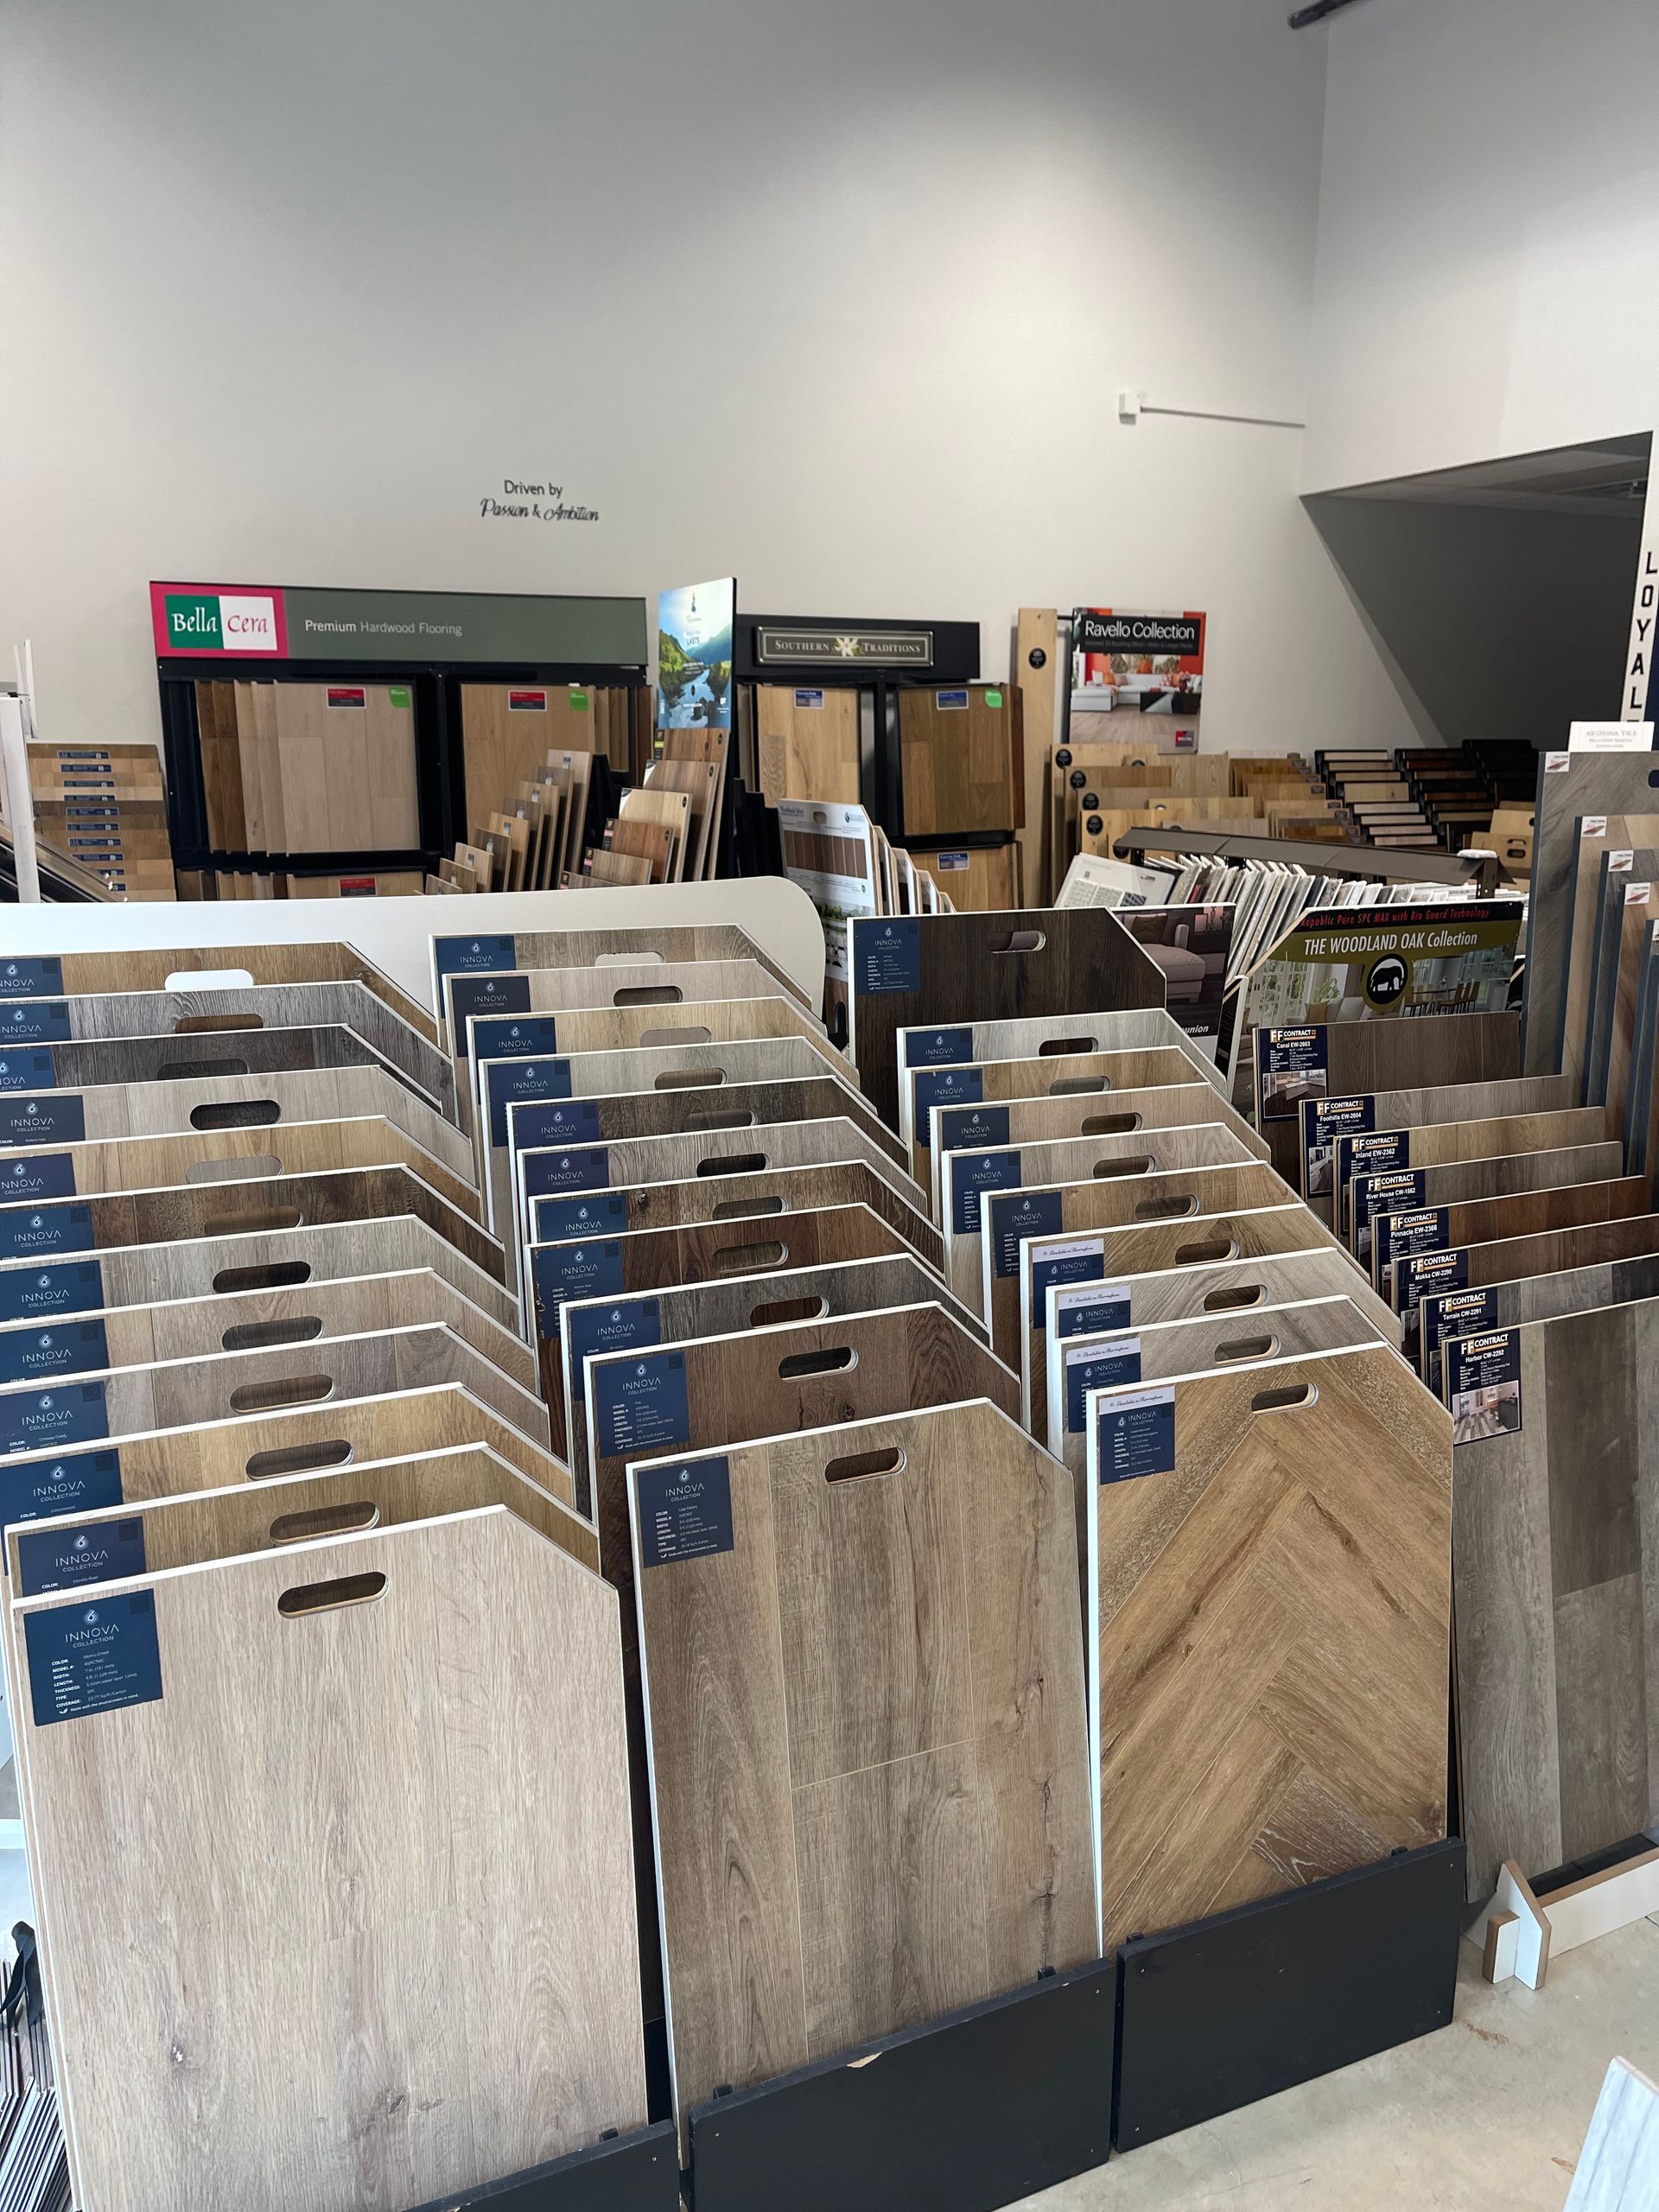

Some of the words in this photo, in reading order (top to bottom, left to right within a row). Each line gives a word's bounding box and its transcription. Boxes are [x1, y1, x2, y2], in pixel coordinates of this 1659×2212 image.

[504, 479, 544, 495] Driven
[549, 482, 563, 499] by
[480, 498, 529, 518] Passion
[532, 503, 542, 518] &
[543, 503, 601, 521] Ambition
[172, 607, 218, 632] Bella
[227, 614, 268, 633] Cera
[305, 620, 357, 633] Premium
[359, 620, 416, 634] Hardwood
[418, 622, 463, 637] Flooring
[1084, 620, 1131, 638] Ravello
[1133, 621, 1195, 640] Collection
[1628, 551, 1658, 722] LOYAL
[774, 639, 830, 651] SOUTHERN
[862, 641, 921, 652] TRADITIONS
[1357, 912, 1372, 924] SPC
[1374, 912, 1389, 923] MAX
[1392, 910, 1408, 922] with
[1411, 910, 1423, 921] Bio
[1426, 908, 1447, 920] Guard
[1450, 906, 1490, 921] Technology
[1305, 938, 1326, 956] THE
[1330, 933, 1397, 954] WOODLAND
[1401, 931, 1425, 950] OAK
[1427, 930, 1478, 948] Collection
[0, 979, 35, 988] NNOVA
[0, 1024, 41, 1033] NNOVA
[1183, 1024, 1210, 1035] union
[499, 1039, 532, 1048] INNOVA
[925, 1046, 954, 1056] INNOVA
[513, 1079, 548, 1090] INNOVA
[934, 1086, 963, 1096] INNOVA
[1331, 1100, 1359, 1109] CONTRACT
[10, 1116, 54, 1127] INNOVA
[541, 1124, 576, 1134] INNOVA
[961, 1125, 990, 1135] INNOVA
[1365, 1137, 1394, 1146] CONTRACT
[548, 1171, 584, 1181] INNOVA
[972, 1170, 1002, 1180] INNOVA
[1381, 1174, 1414, 1185] CONTRACT
[1, 1177, 44, 1189] NNOVA
[1011, 1211, 1042, 1223] INNOVA
[1403, 1213, 1433, 1224] CONTRACT
[565, 1220, 602, 1231] INNOVA
[14, 1230, 62, 1243] INNOVA
[1390, 1229, 1414, 1238] Pinnacle
[1060, 1261, 1088, 1270] INNOVA
[1423, 1254, 1458, 1267] CONTRACT
[562, 1263, 599, 1275] INNOVA
[1414, 1272, 1431, 1281] Mokka
[21, 1289, 70, 1303] INNOVA
[1452, 1293, 1486, 1306] CONTRACT
[1085, 1307, 1114, 1318] INNOVA
[1442, 1312, 1460, 1321] Terrain
[597, 1323, 636, 1336] INNOVA
[1474, 1333, 1509, 1347] CONTRACT
[22, 1349, 72, 1363] INNOVA
[1465, 1354, 1483, 1363] Harbor
[1094, 1361, 1123, 1372] INNOVA
[622, 1376, 661, 1391] INNOVA
[22, 1409, 73, 1426] INNOVA
[1128, 1411, 1157, 1422] INNOVA
[33, 1480, 86, 1497] INNOVA
[665, 1483, 705, 1497] INNOVA
[55, 1550, 109, 1567] INNOVA
[62, 1561, 104, 1573] COLLECTION
[65, 1624, 120, 1643] INNOVA
[73, 1635, 114, 1649] COLLECTION
